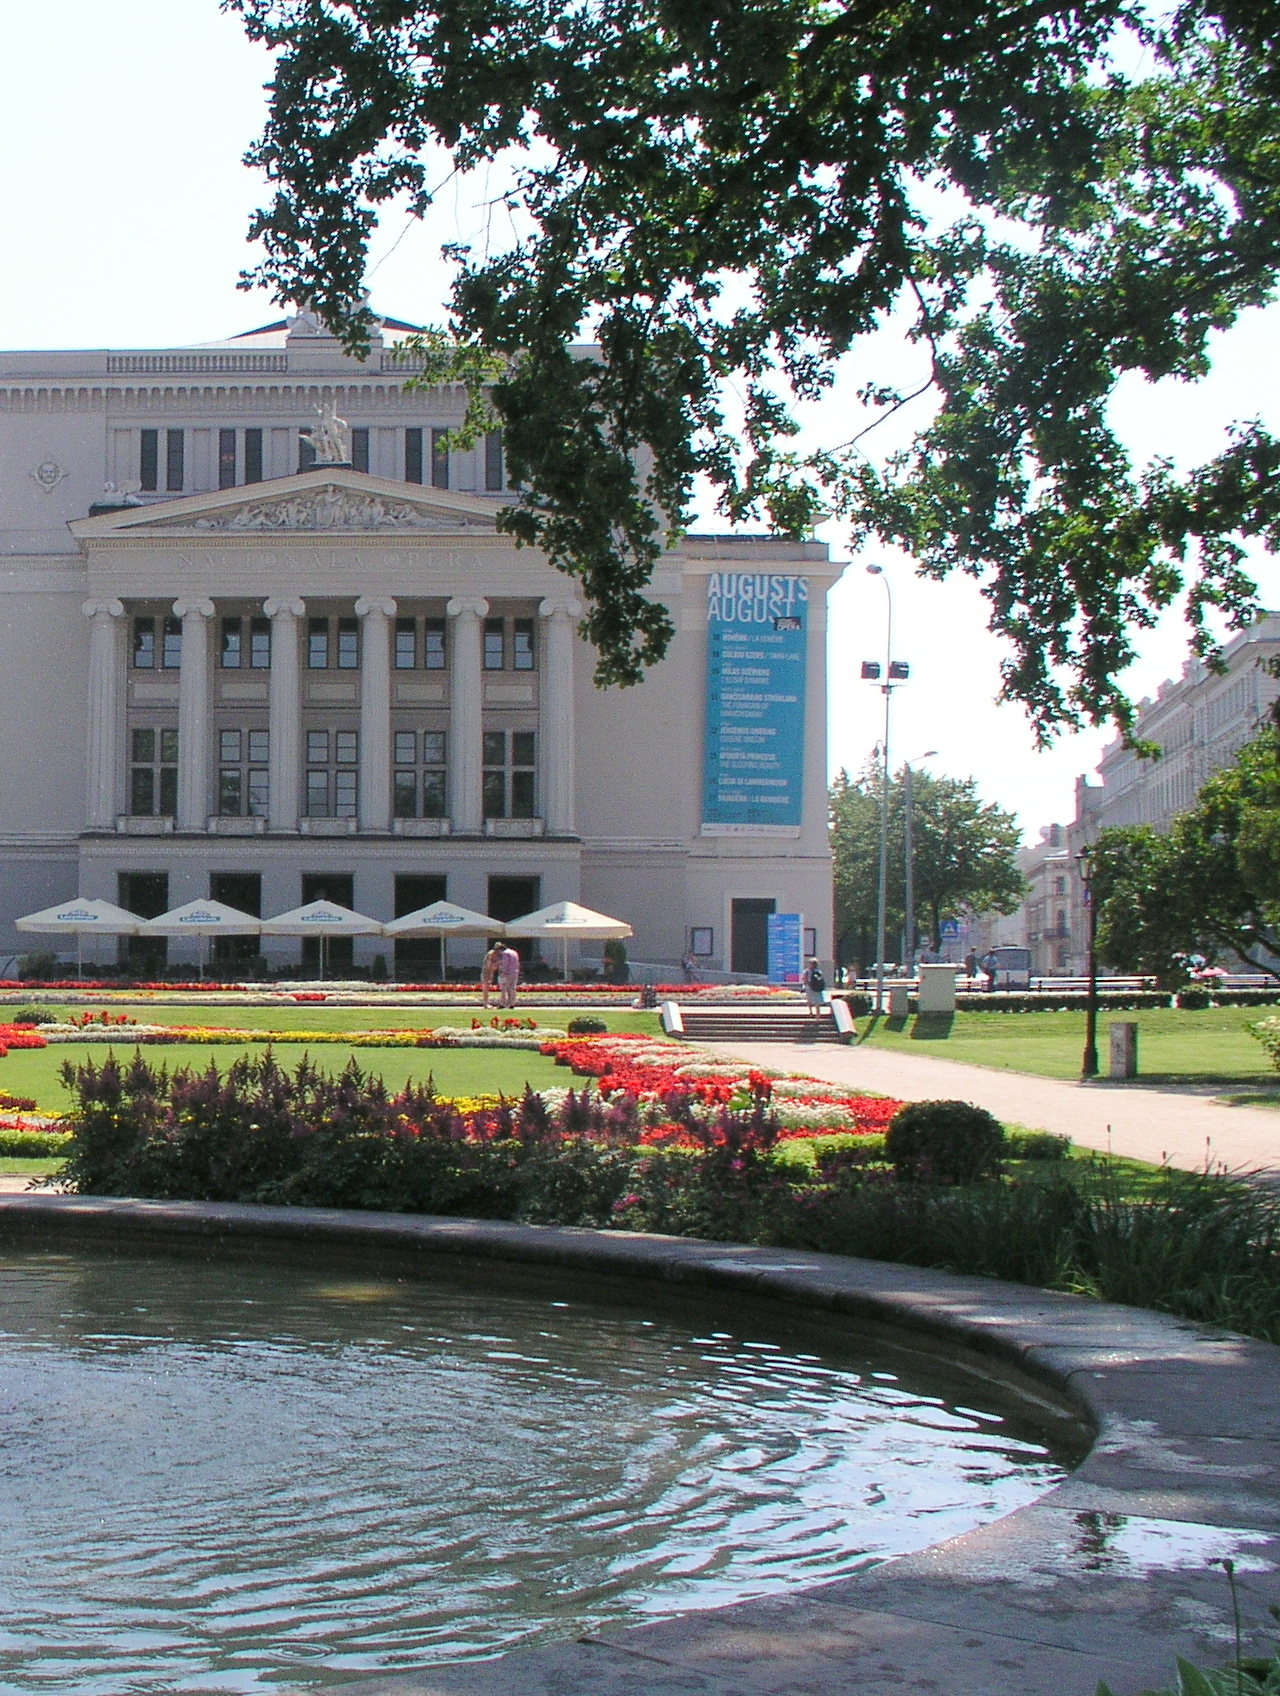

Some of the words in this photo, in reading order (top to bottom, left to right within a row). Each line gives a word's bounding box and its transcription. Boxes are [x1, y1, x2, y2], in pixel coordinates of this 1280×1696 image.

[382, 551, 483, 567] OPERA
[707, 573, 809, 601] AUGUSTS
[707, 597, 796, 623] AUGUST
